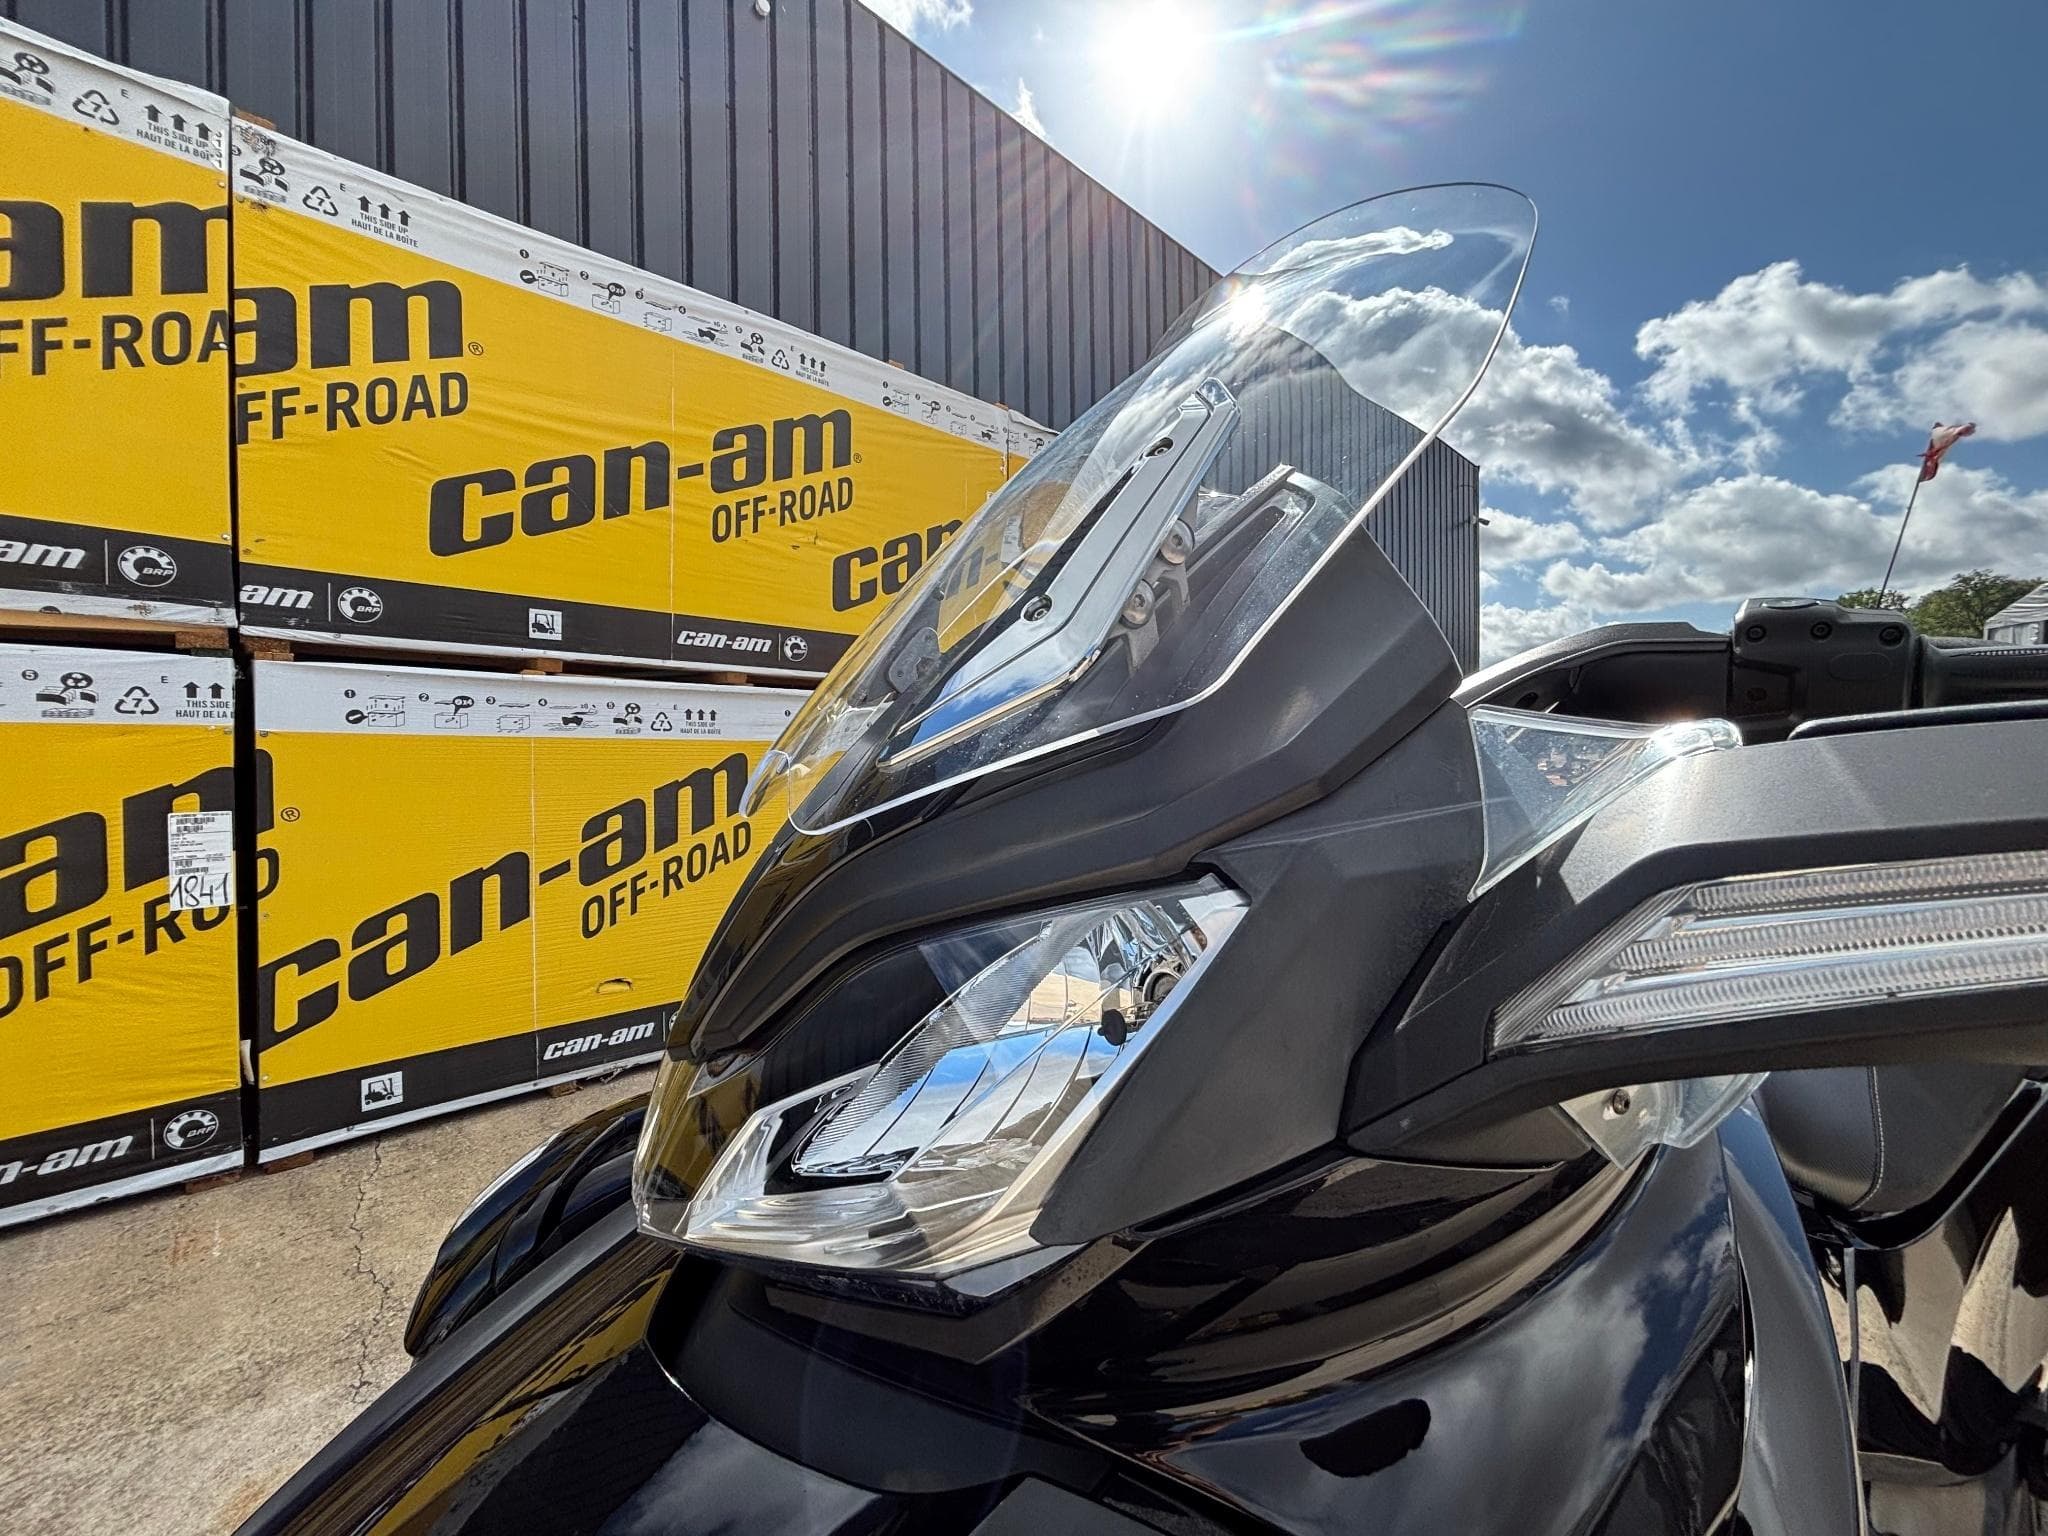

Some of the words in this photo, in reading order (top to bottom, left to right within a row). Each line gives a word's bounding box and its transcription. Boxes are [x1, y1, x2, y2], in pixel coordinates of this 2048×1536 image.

[136, 129, 162, 145] HAUT
[164, 138, 178, 150] DE
[179, 144, 190, 154] LA
[147, 121, 170, 136] THIS
[171, 131, 193, 145] SIDE
[195, 138, 209, 149] UP
[351, 218, 372, 231] HAUT
[373, 226, 384, 236] DE
[385, 231, 395, 240] LA
[360, 212, 378, 226] THIS
[380, 219, 396, 232] SIDE
[398, 226, 409, 235] UP
[429, 409, 852, 557] can-am
[711, 476, 853, 543] OFF-ROAD
[142, 567, 174, 577] BRP
[356, 605, 381, 614] BRP
[676, 630, 773, 653] can-am
[161, 676, 168, 684] E
[175, 709, 200, 718] HAUT
[202, 710, 216, 718] DE
[186, 700, 208, 708] THIS
[210, 701, 230, 709] SIDE
[170, 872, 228, 909] 1841
[582, 821, 751, 939] OFF-ROAD
[257, 752, 748, 1054] can-am
[543, 1022, 655, 1060] can-am
[186, 1125, 216, 1138] BRP
